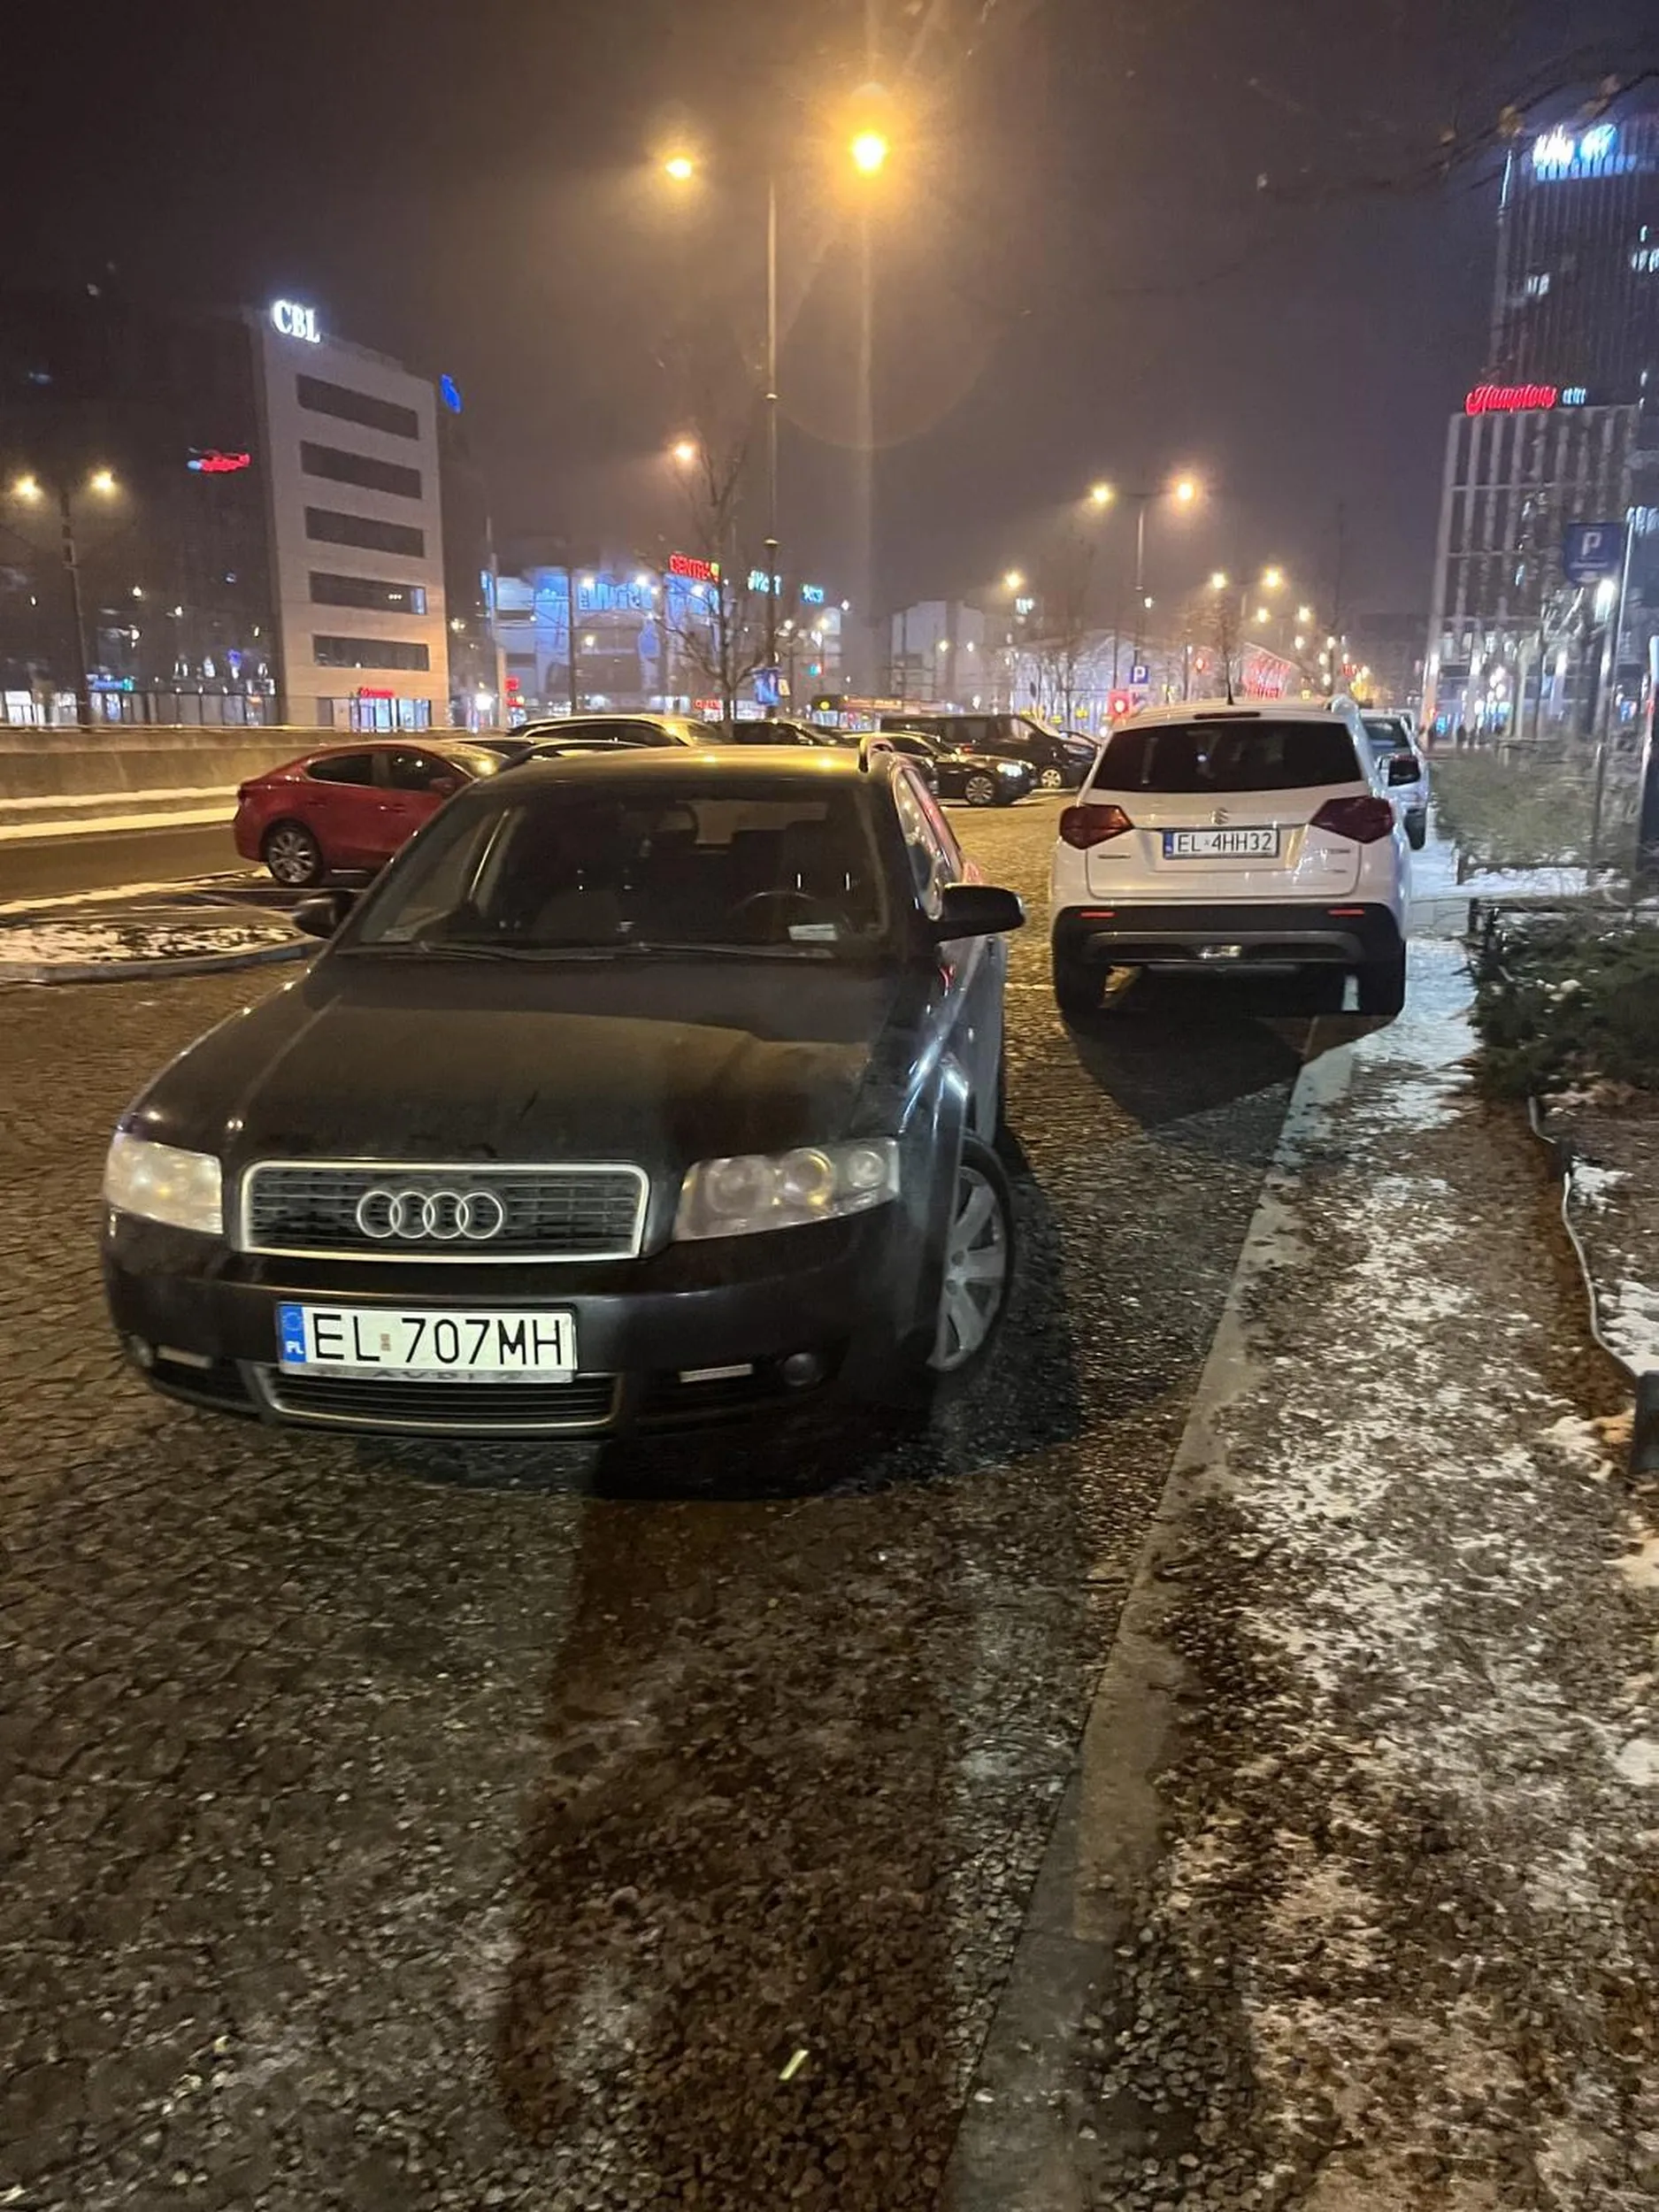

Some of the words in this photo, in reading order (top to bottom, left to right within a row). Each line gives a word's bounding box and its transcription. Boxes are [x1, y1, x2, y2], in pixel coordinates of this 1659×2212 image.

[273, 300, 320, 343] CBL
[1582, 532, 1601, 556] P
[1133, 665, 1146, 682] P
[1178, 834, 1202, 852] EL
[1211, 833, 1272, 851] 4HH32
[286, 1340, 303, 1355] PL
[313, 1313, 380, 1362] EL
[402, 1317, 561, 1363] 707MH
